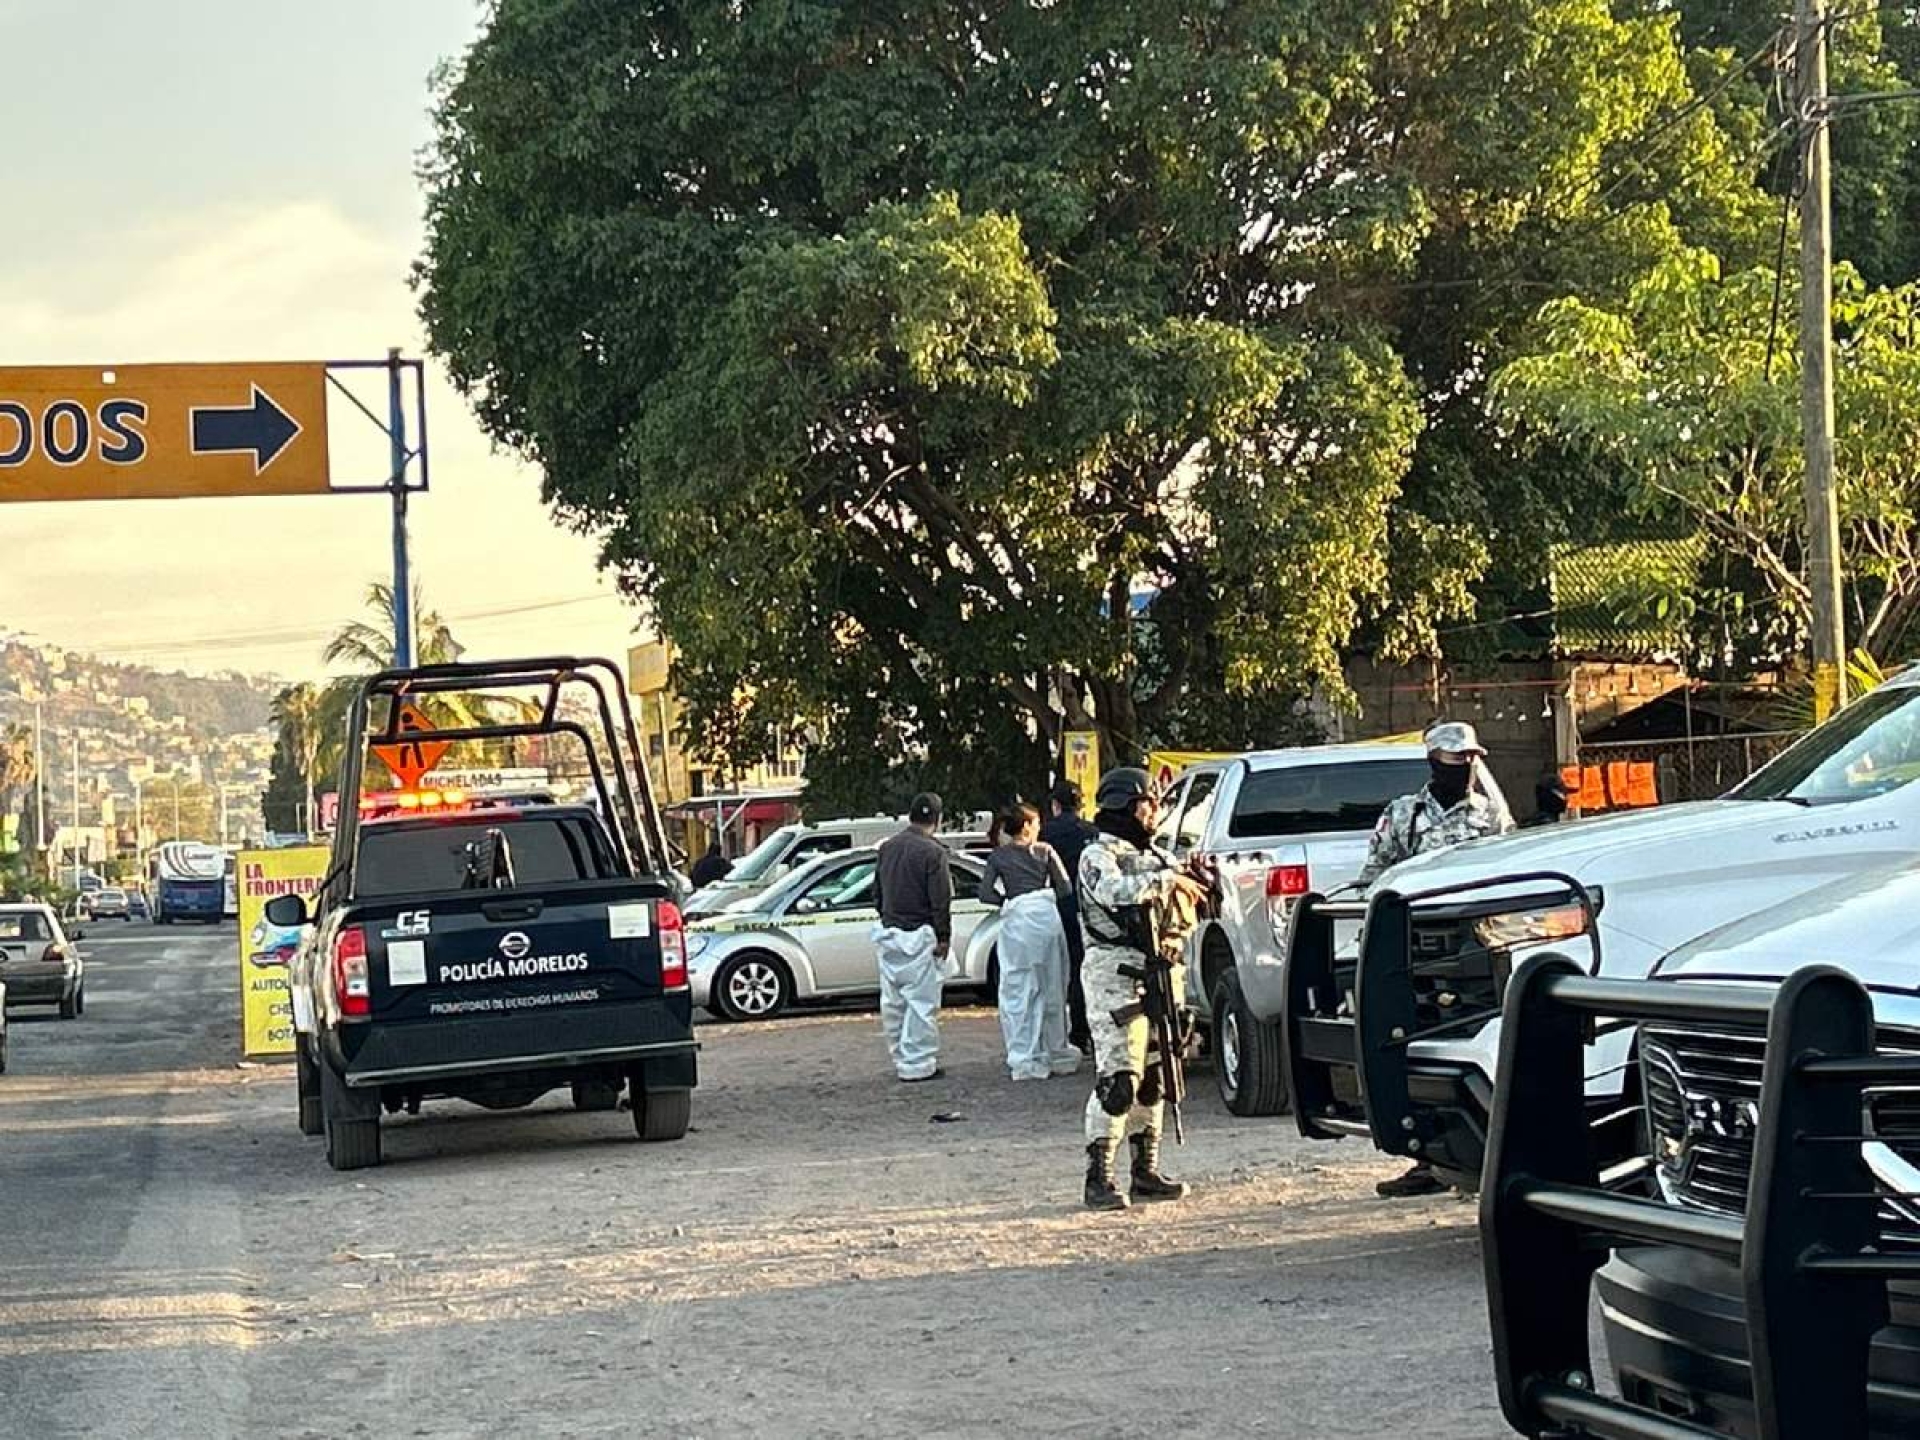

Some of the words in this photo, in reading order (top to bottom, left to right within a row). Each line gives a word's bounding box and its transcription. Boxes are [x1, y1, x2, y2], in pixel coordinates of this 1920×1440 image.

[0, 400, 148, 468] DOS
[424, 773, 502, 788] MICHELADAS
[245, 863, 264, 879] LA
[439, 956, 505, 983] POLICÍA
[508, 952, 589, 977] MORELOS
